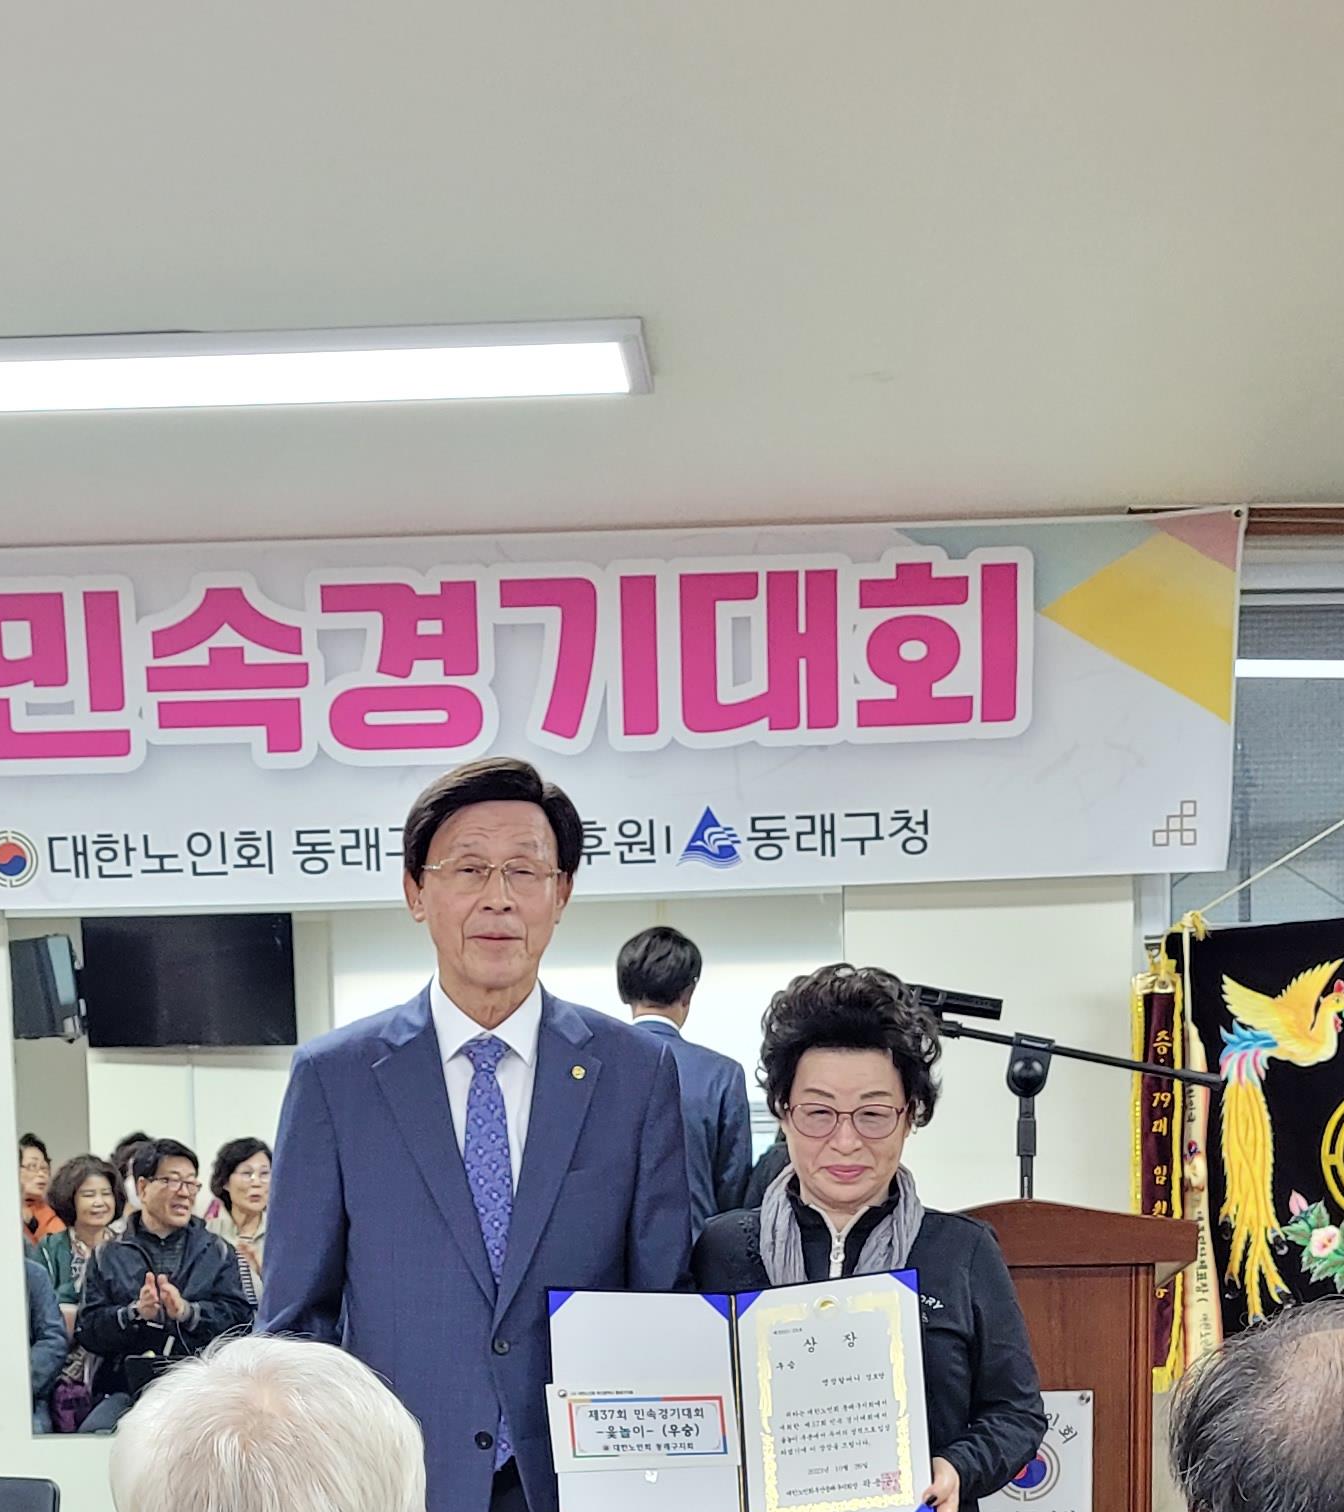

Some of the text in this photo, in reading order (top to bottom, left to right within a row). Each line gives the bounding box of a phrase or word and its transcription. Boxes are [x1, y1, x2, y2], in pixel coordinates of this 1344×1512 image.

[47, 829, 274, 880] 대한노인회
[747, 808, 929, 862] 동래구청
[588, 1407, 705, 1421] 제37회 민속경기대회
